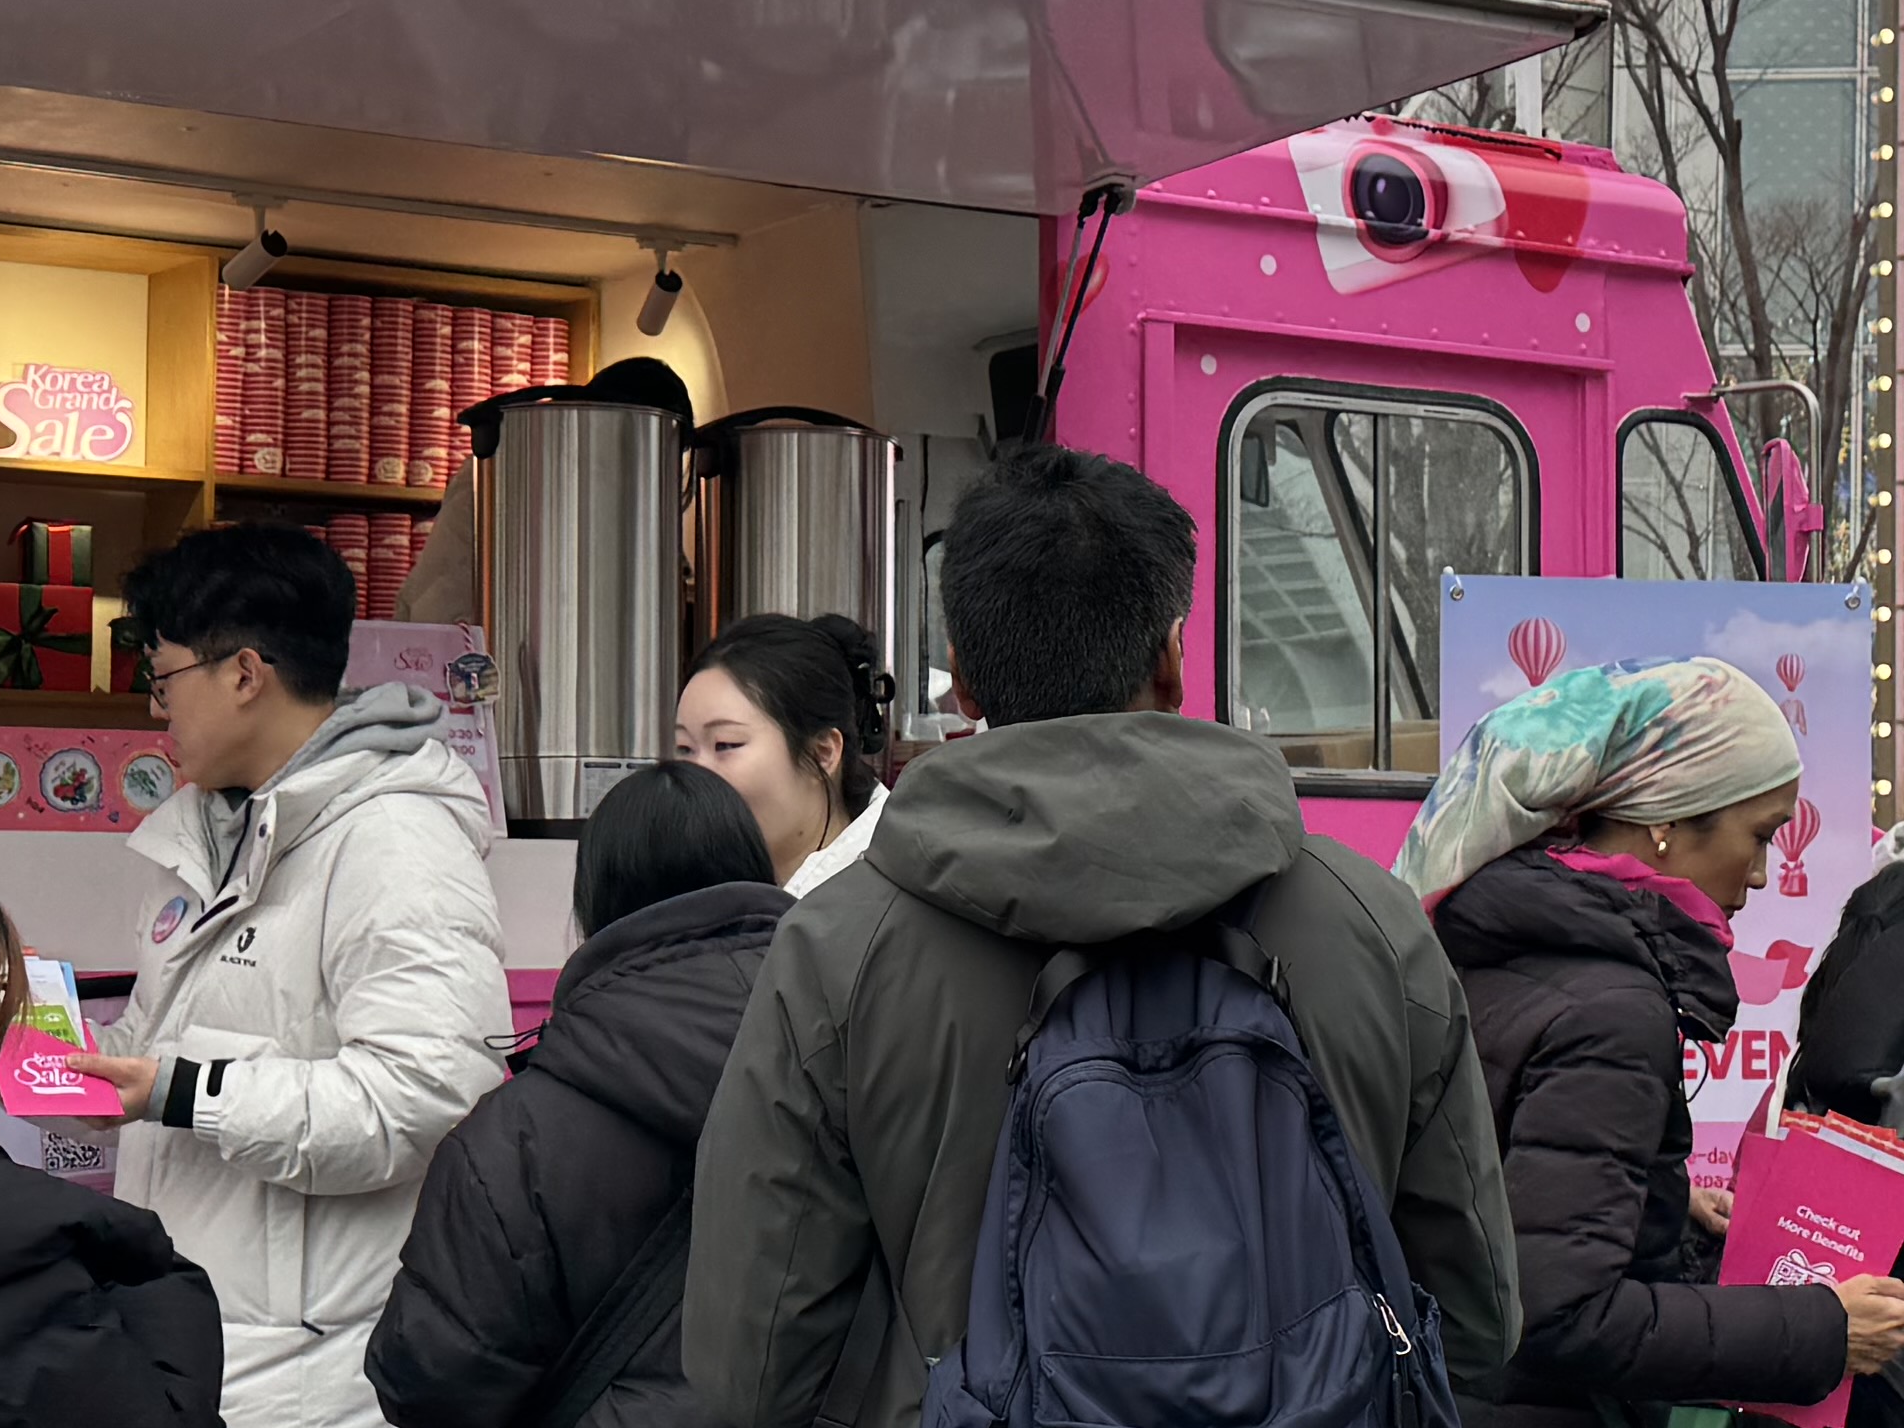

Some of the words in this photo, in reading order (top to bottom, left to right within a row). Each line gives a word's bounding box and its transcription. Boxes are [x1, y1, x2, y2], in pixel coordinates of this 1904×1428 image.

[25, 364, 110, 393] Korea
[33, 386, 118, 411] Grand
[1776, 1215, 1811, 1239] More
[1811, 1232, 1865, 1263] Benefits
[1795, 1204, 1836, 1230] Check
[1837, 1223, 1862, 1241] out
